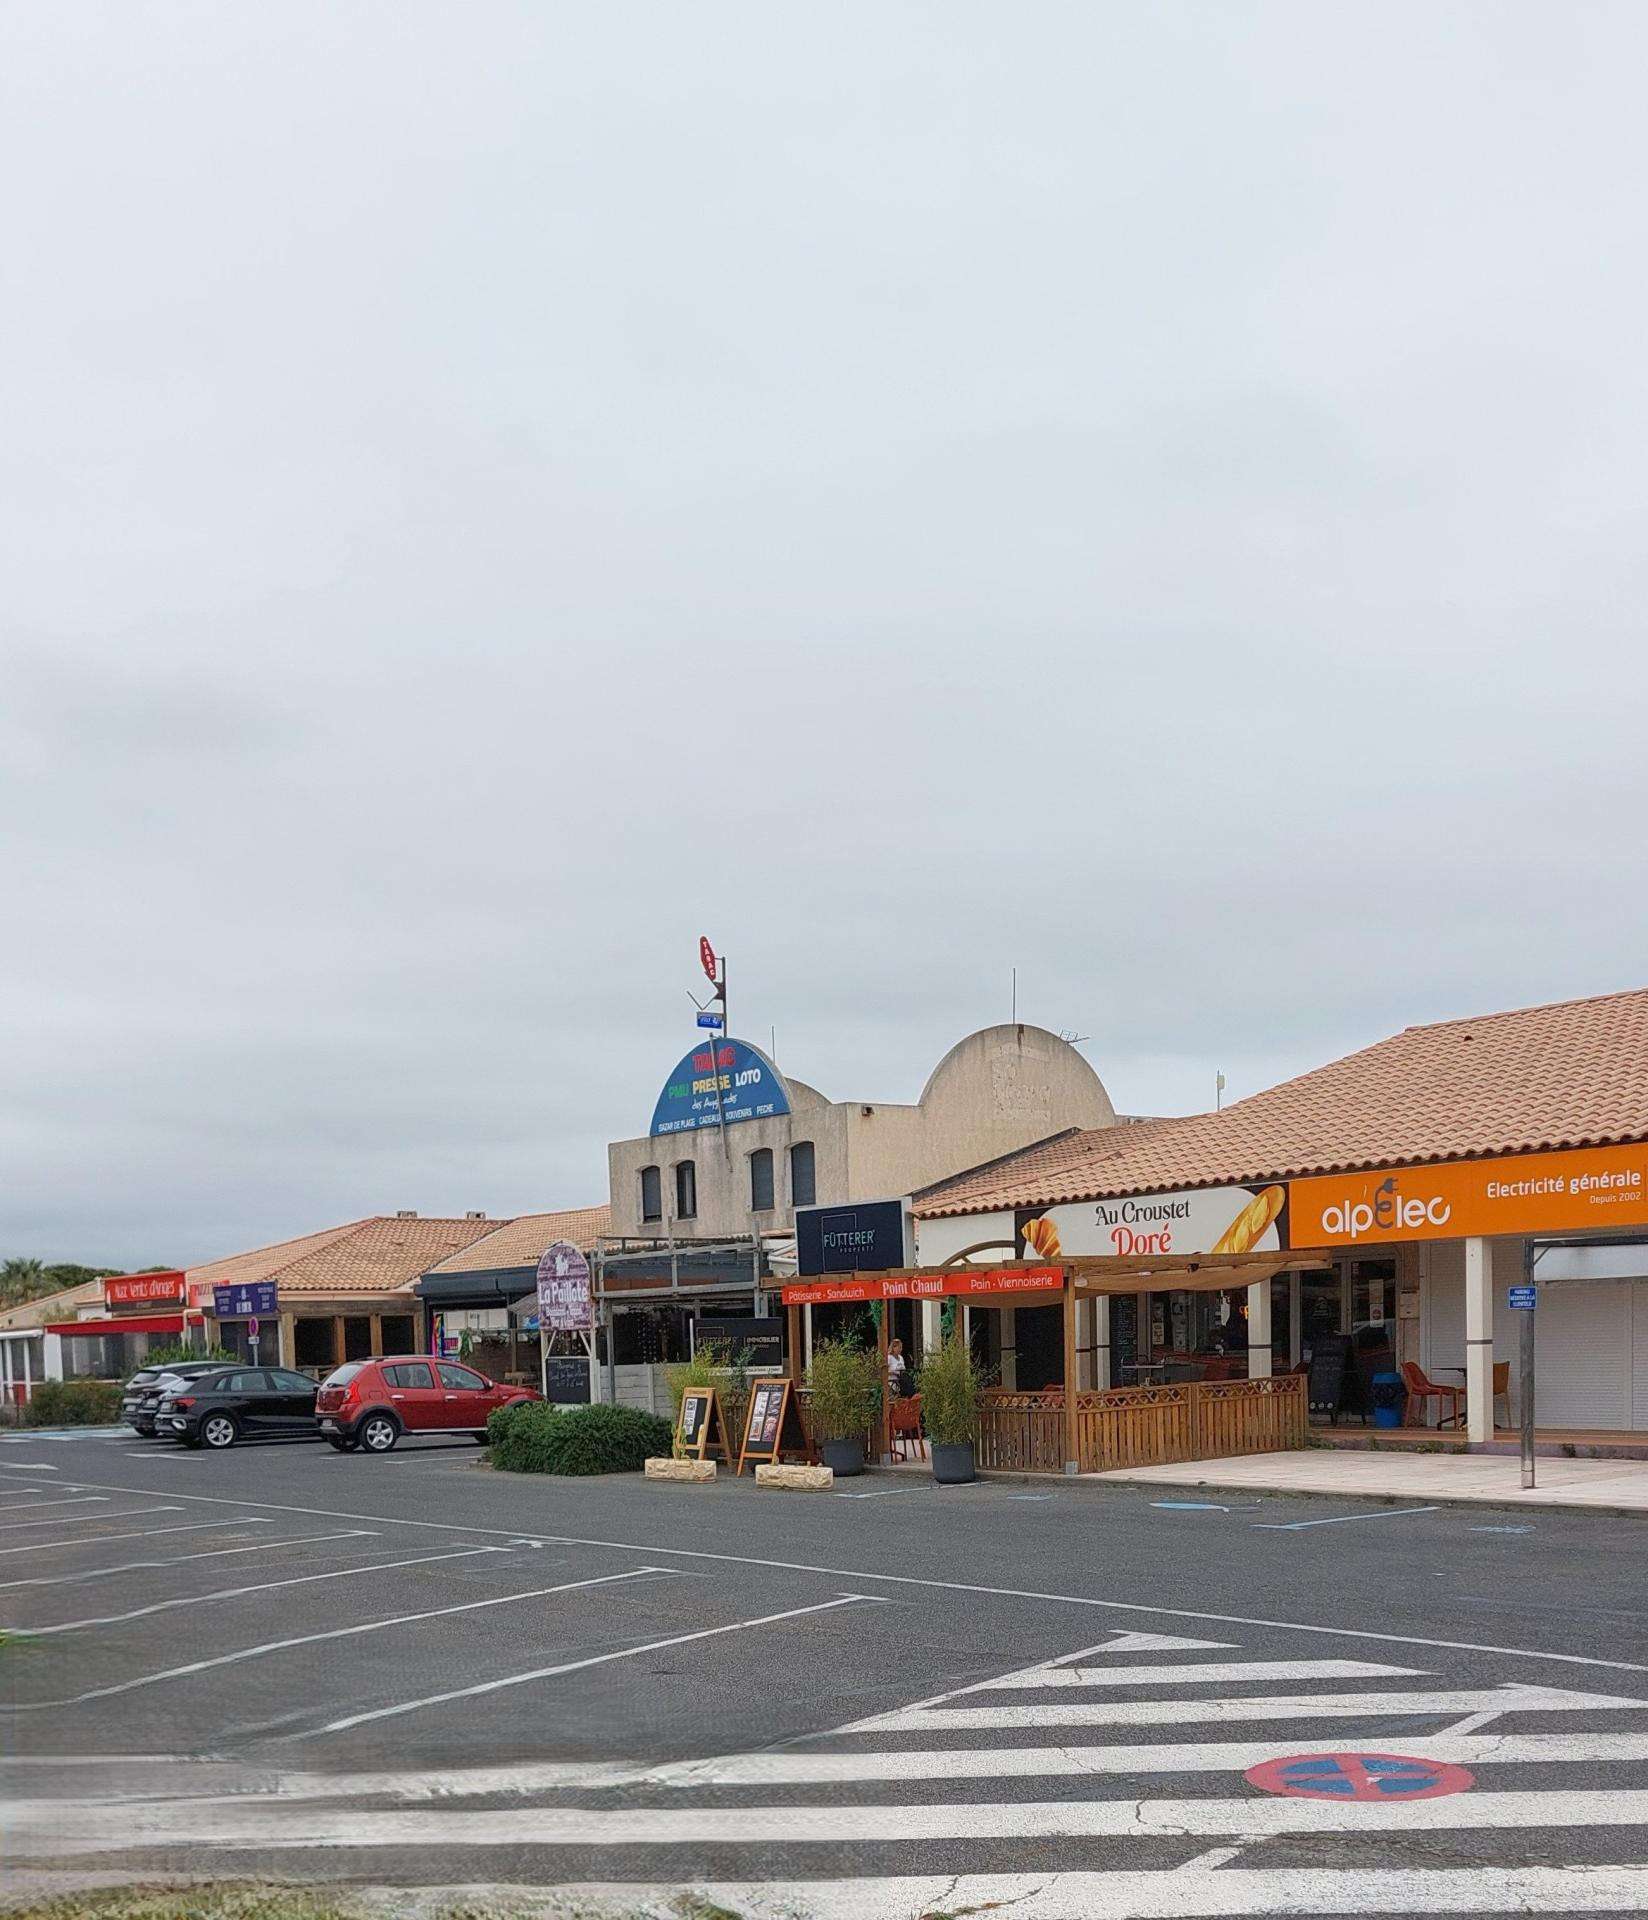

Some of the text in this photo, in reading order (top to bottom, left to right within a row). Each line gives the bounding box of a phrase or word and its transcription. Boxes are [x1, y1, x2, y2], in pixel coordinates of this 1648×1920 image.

[692, 1075, 731, 1095] PRESSE
[735, 1068, 761, 1087] LOTO
[1487, 1169, 1642, 1198] Electricité générale
[1589, 1192, 1642, 1205] Depuis 2002
[1095, 1199, 1191, 1226] Au Croustet
[1111, 1223, 1172, 1256] Doré
[539, 1280, 588, 1304] La Paillote
[827, 1286, 865, 1300] Sandwich
[882, 1277, 944, 1296] Point Chaud
[970, 1274, 1053, 1290] Pain Viennoiserie
